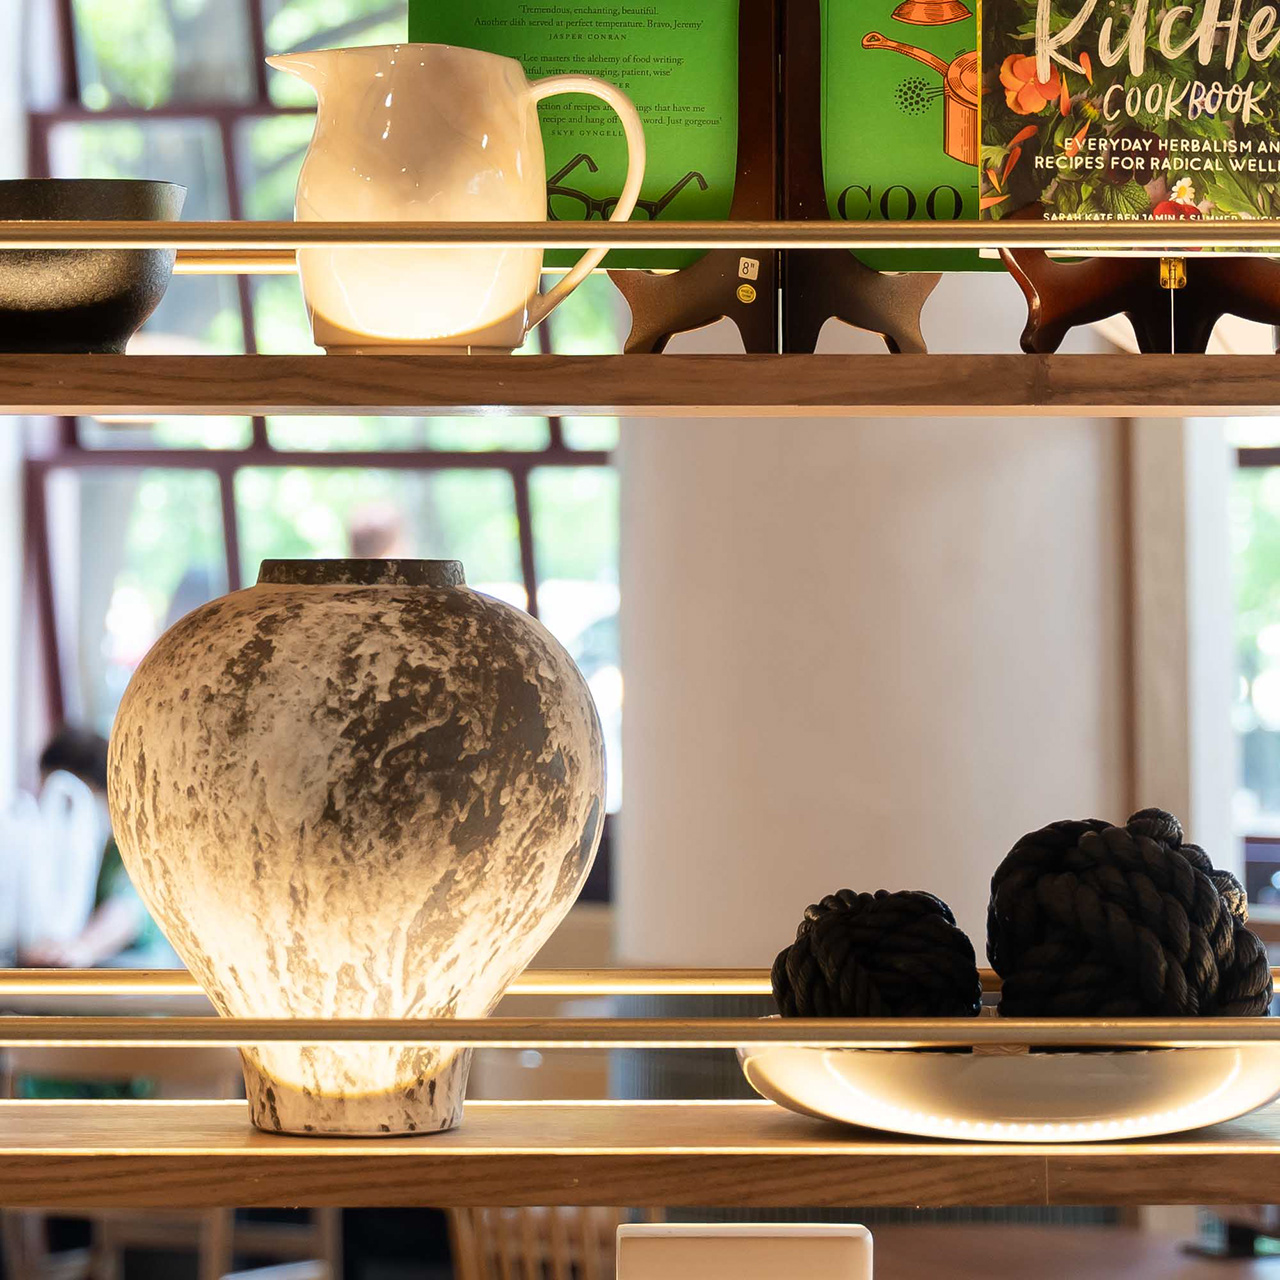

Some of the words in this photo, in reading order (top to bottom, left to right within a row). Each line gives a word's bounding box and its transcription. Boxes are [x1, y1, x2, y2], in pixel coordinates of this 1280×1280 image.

[573, 5, 620, 18] enchanting,
[621, 6, 658, 15] beautiful.
[549, 33, 582, 41] JASPER
[587, 33, 627, 41] CONRAN
[523, 53, 539, 63] Lee
[540, 54, 571, 63] masters
[572, 54, 586, 63] the
[587, 54, 621, 66] alchemy
[632, 54, 651, 64] food
[652, 55, 684, 67] writing:
[1103, 77, 1271, 124] COOKBOOK
[573, 102, 601, 114] recipes
[654, 103, 671, 112] that
[672, 103, 691, 112] have
[542, 115, 567, 127] recipe
[568, 114, 583, 124] and
[584, 114, 605, 127] hang
[606, 114, 618, 124] off
[1064, 138, 1151, 152] EVERYDAY
[1158, 139, 1252, 153] HERBALISM
[1035, 156, 1105, 170] RECIPES
[1111, 157, 1145, 170] FOR
[1150, 157, 1223, 171] RADICAL
